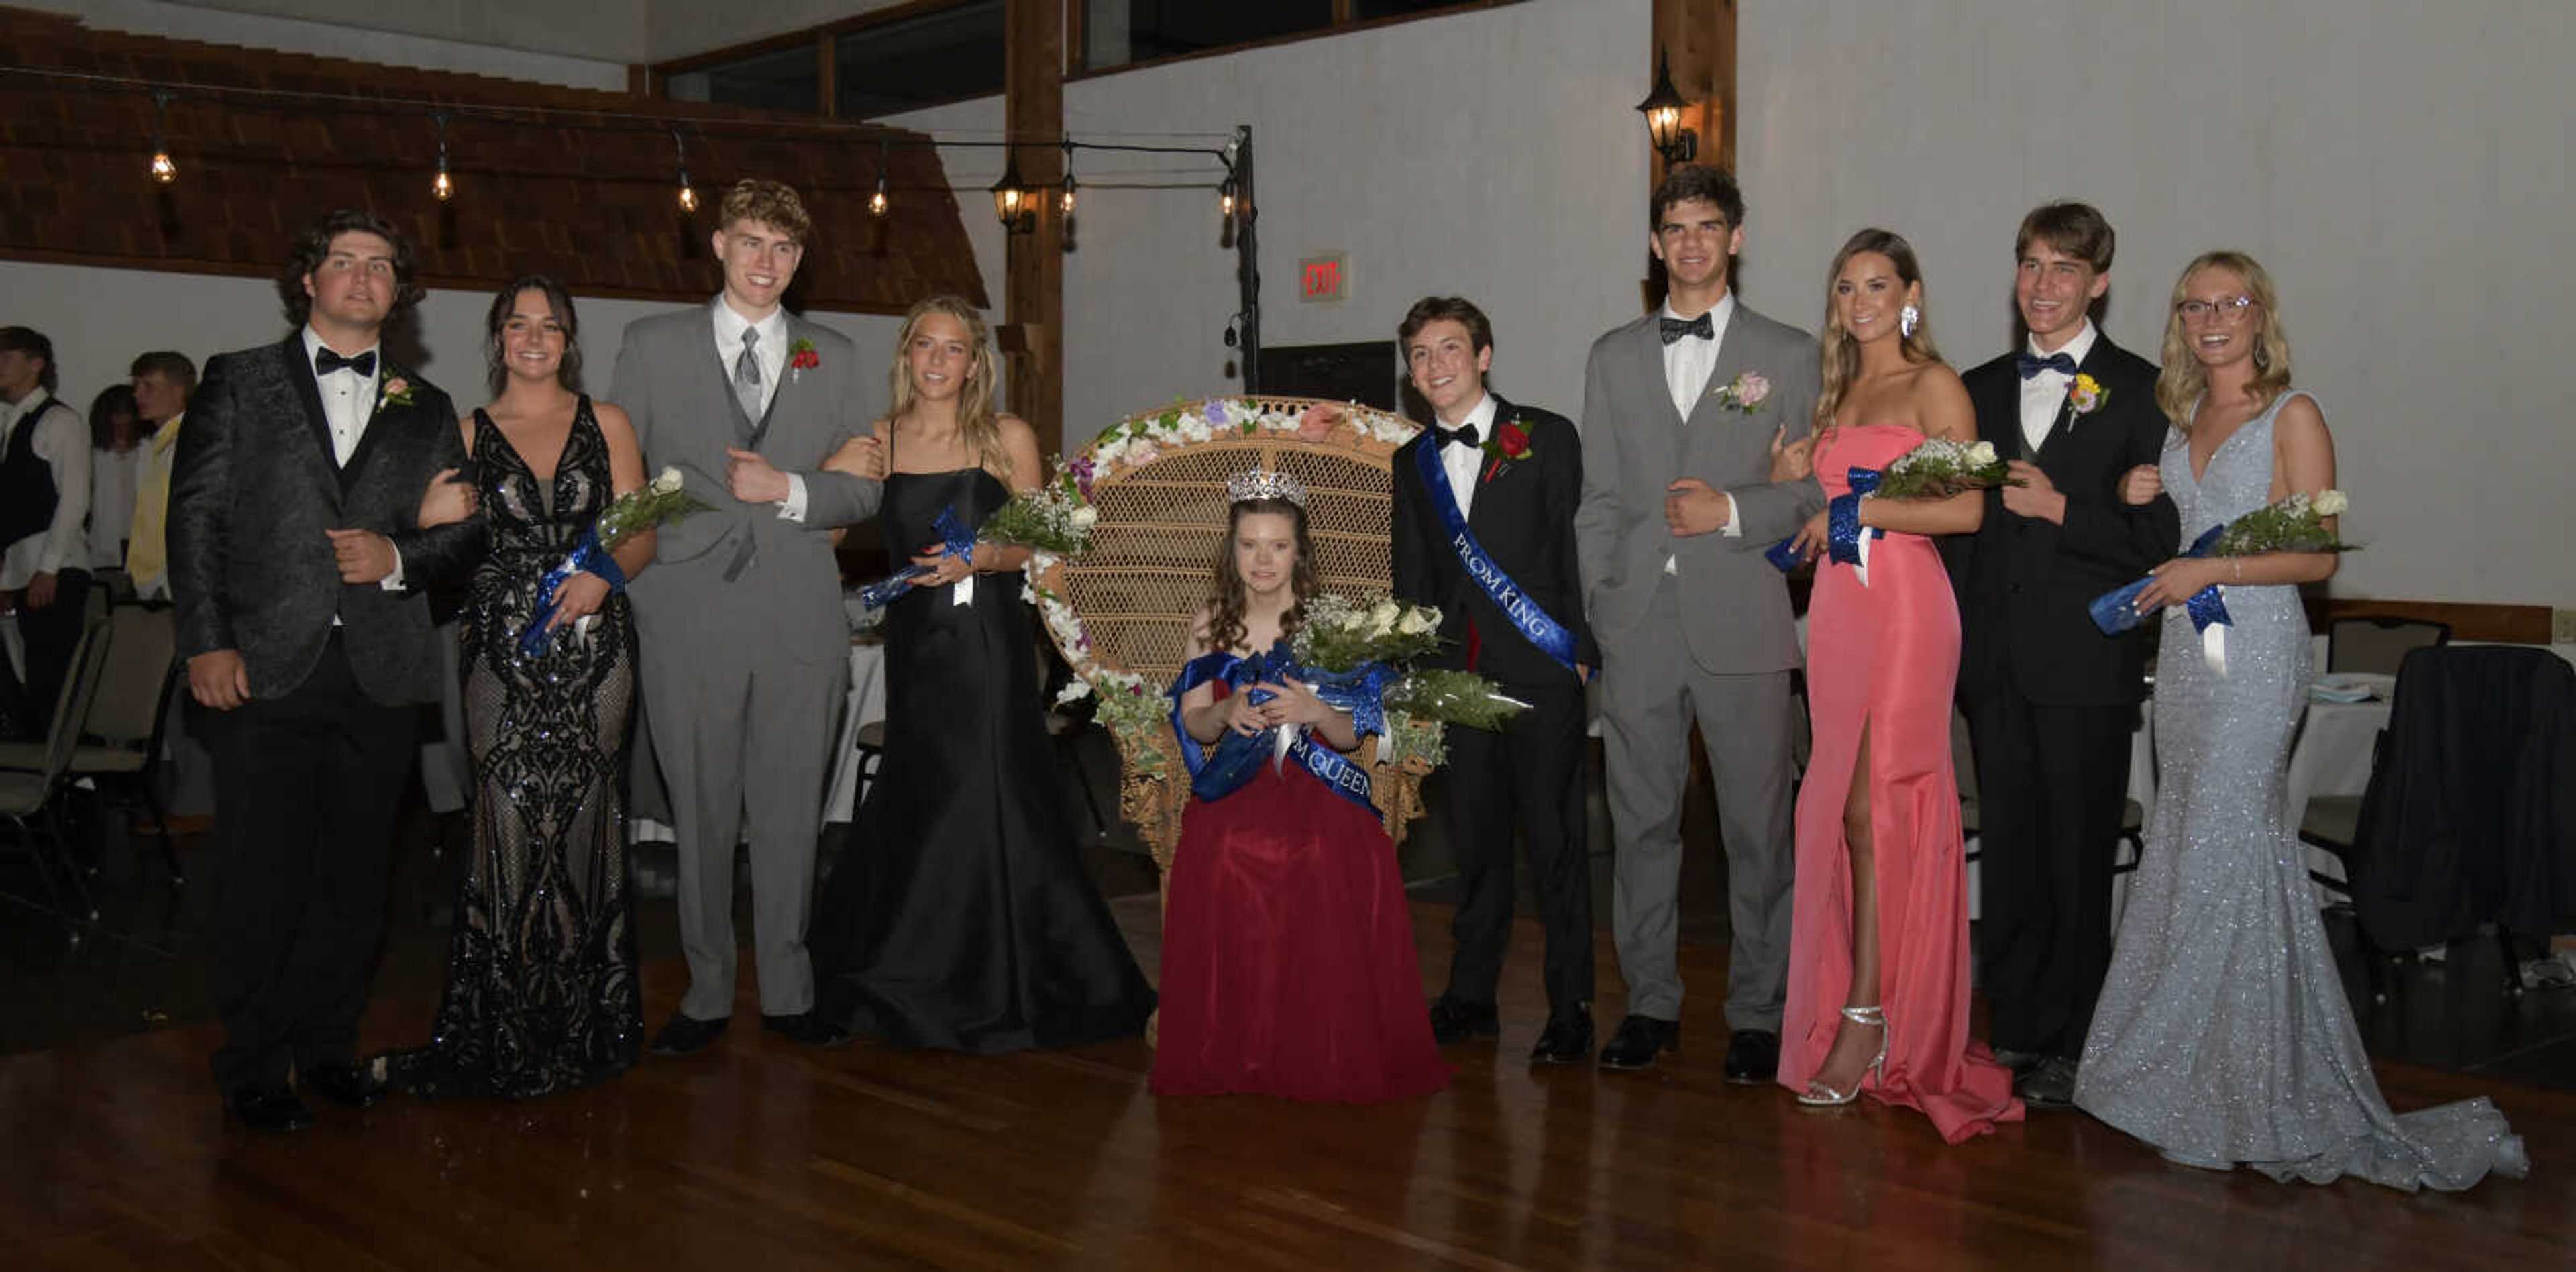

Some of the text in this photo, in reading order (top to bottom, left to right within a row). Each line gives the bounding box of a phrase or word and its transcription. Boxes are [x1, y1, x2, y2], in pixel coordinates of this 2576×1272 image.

[1307, 262, 1337, 295] EXIT
[1454, 533, 1548, 637] PROM KING
